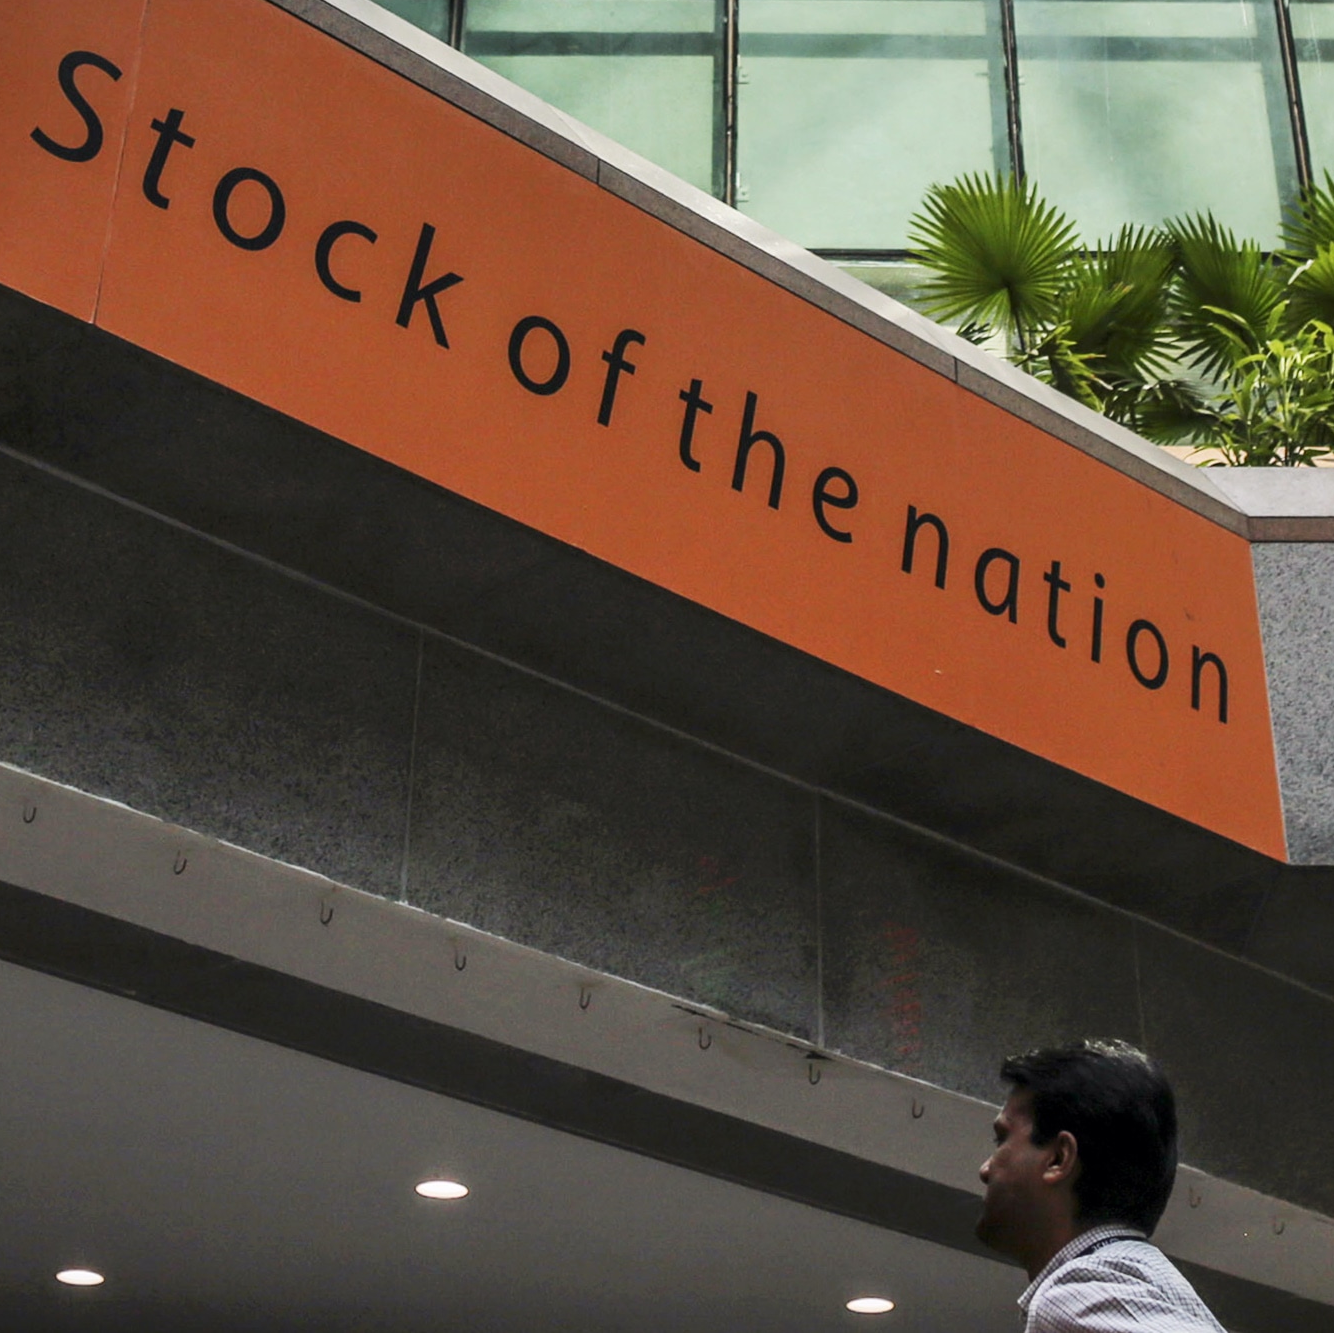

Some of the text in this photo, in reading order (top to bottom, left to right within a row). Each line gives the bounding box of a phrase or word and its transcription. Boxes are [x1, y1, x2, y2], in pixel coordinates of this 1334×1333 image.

[28, 48, 1230, 726] Stock of the nation
